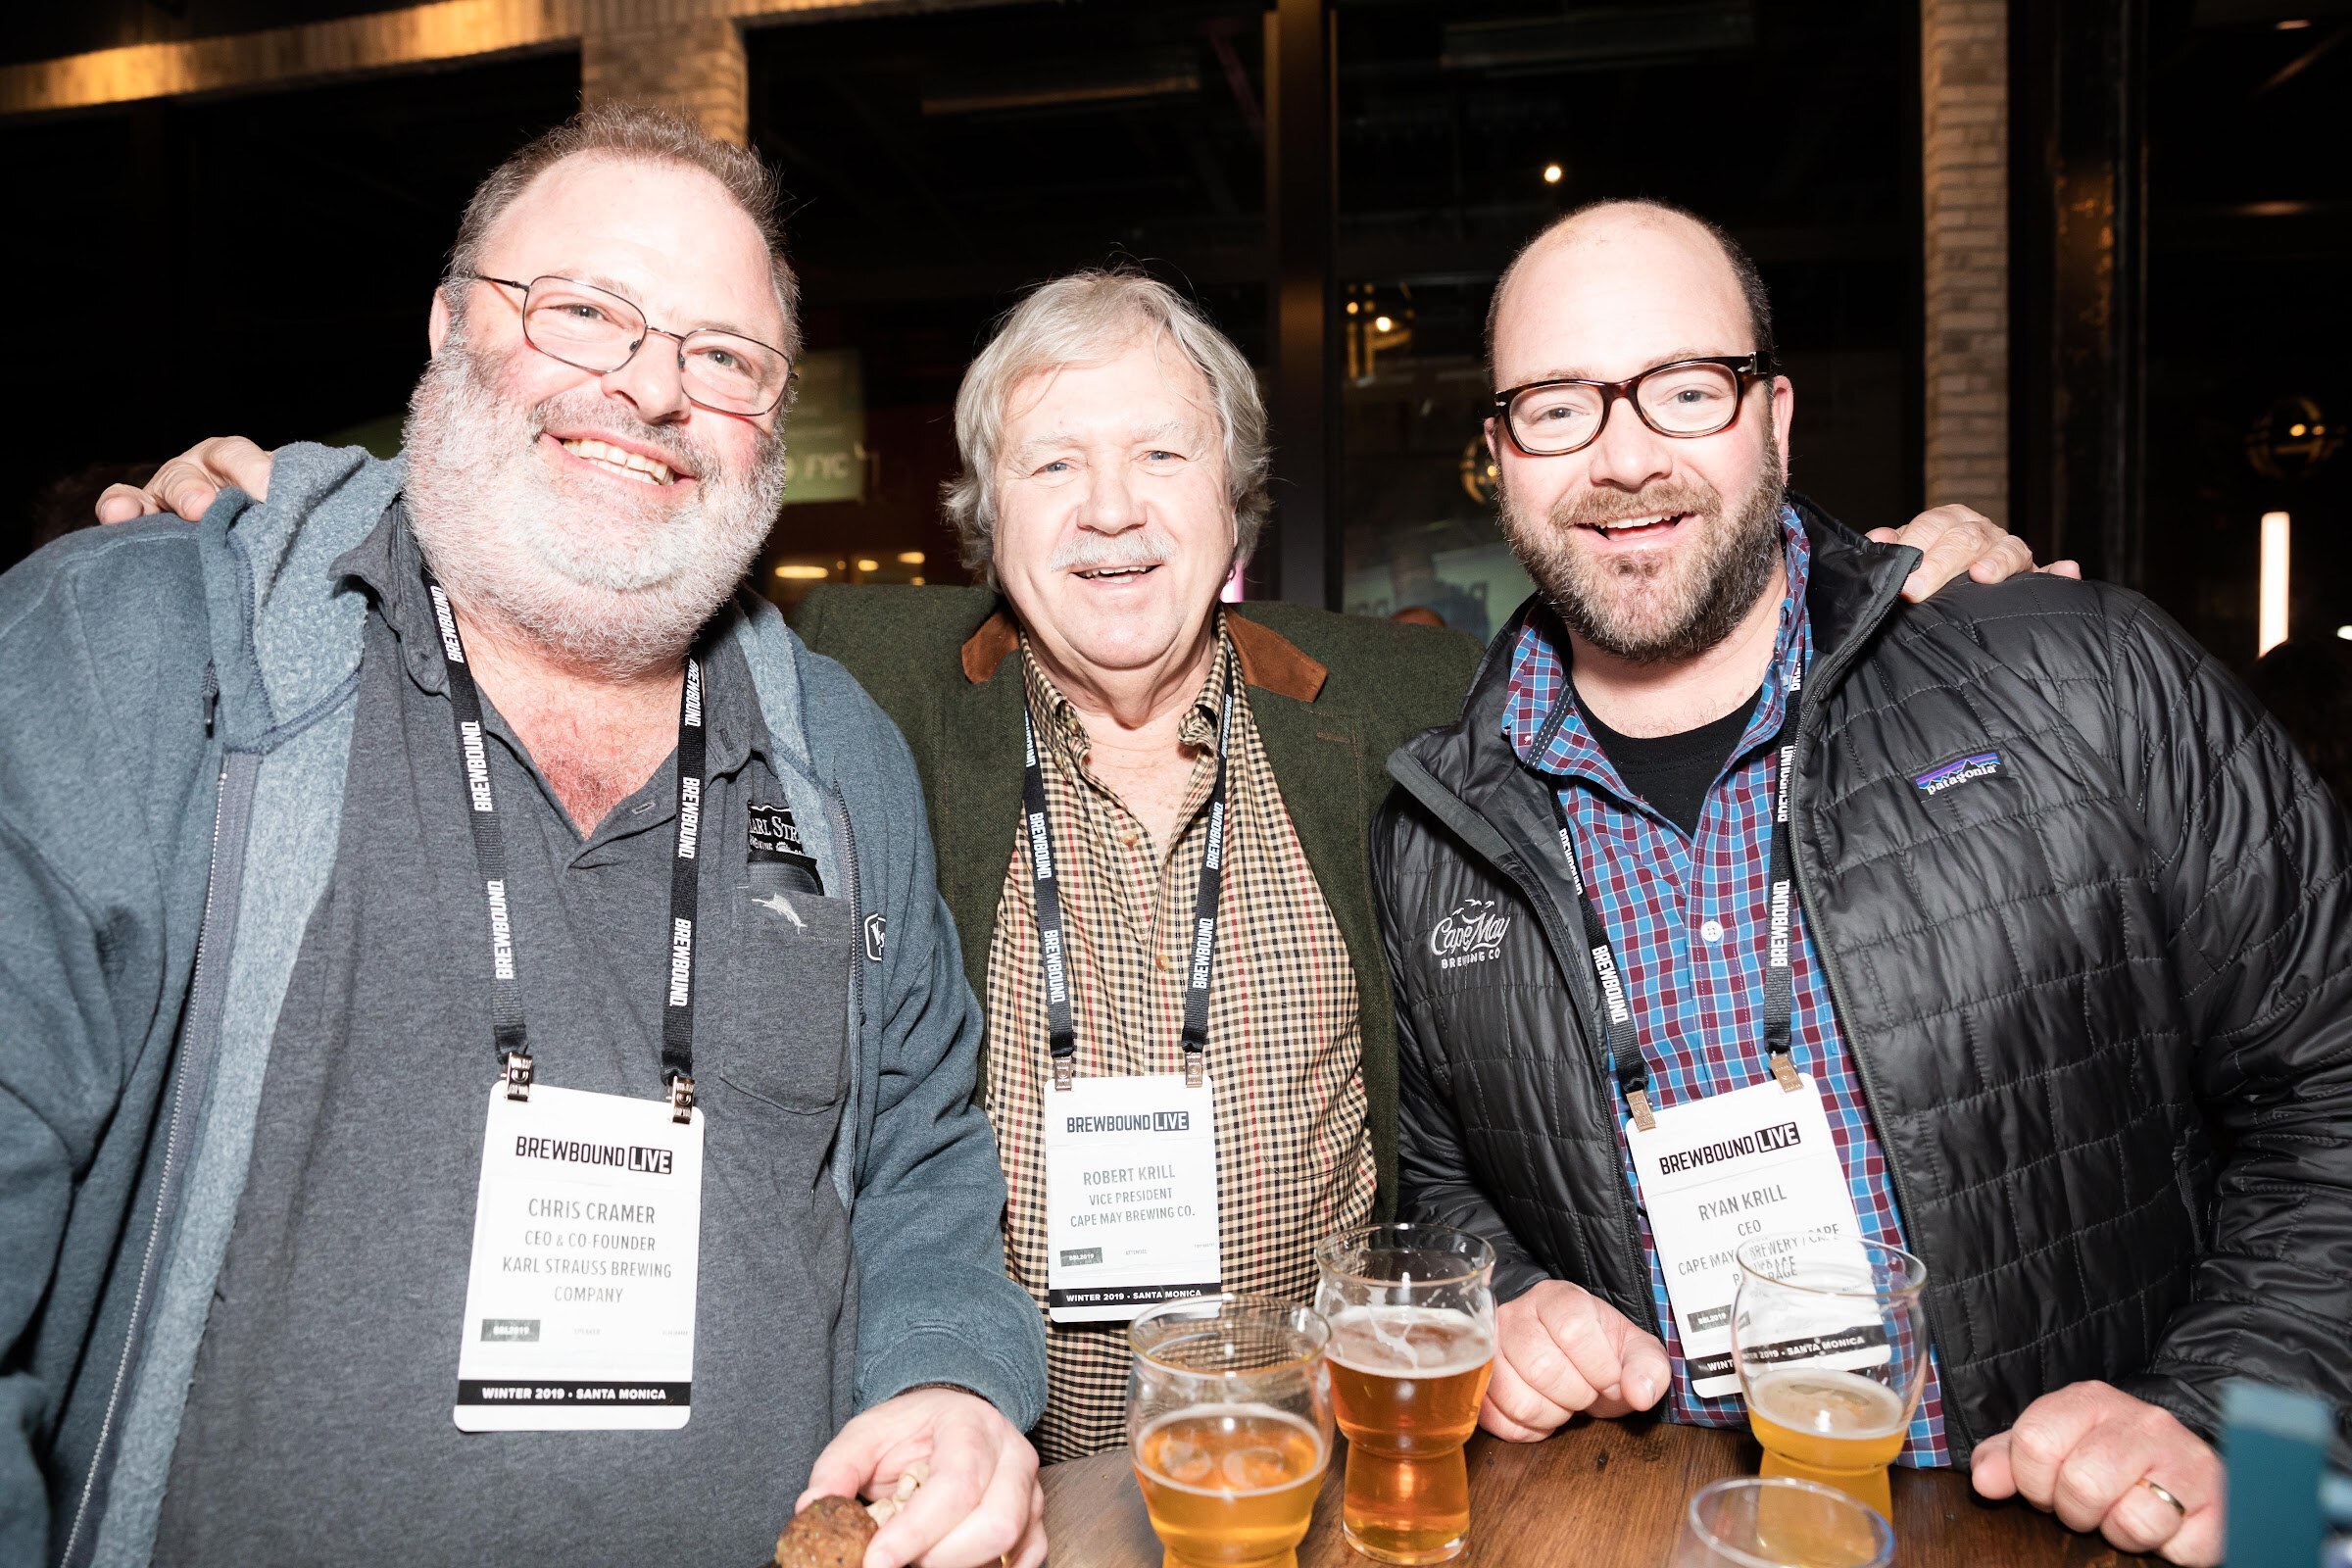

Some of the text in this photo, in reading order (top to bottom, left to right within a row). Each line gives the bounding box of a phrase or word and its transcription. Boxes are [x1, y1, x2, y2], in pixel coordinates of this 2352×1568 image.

[1927, 764, 1996, 795] patagonia
[749, 818, 771, 835] ARL
[1431, 912, 1510, 956] Cape May
[1442, 951, 1486, 969] BREWING
[1067, 1111, 1190, 1134] BREWBOUND LIVE
[515, 1136, 673, 1175] BREWBOUND LIVE
[1659, 1121, 1801, 1175] BREWBOUND LIVE
[1083, 1164, 1176, 1186] ROBERT KRILL
[1089, 1187, 1173, 1206] VICE PRESIDENT
[1698, 1184, 1788, 1221] RYAN KRILL
[528, 1198, 656, 1224] CHRIS CRAMER
[1070, 1204, 1196, 1228] CAPE MAY BREWING CO.
[524, 1230, 552, 1248] CEO
[557, 1234, 564, 1247] &
[1738, 1219, 1761, 1237] CEO
[503, 1256, 672, 1279] KARL STRAUSS BREWING
[1678, 1257, 1708, 1275] CAPE
[1709, 1250, 1735, 1268] MAY
[554, 1286, 624, 1303] COMPANY
[1066, 1289, 1202, 1302] WINTER 2019 SANTA MONICA
[1787, 1343, 1821, 1356] SANTA
[1821, 1336, 1865, 1350] MONICA
[481, 1387, 666, 1400] WINTER 2019 SANTA MONICA
